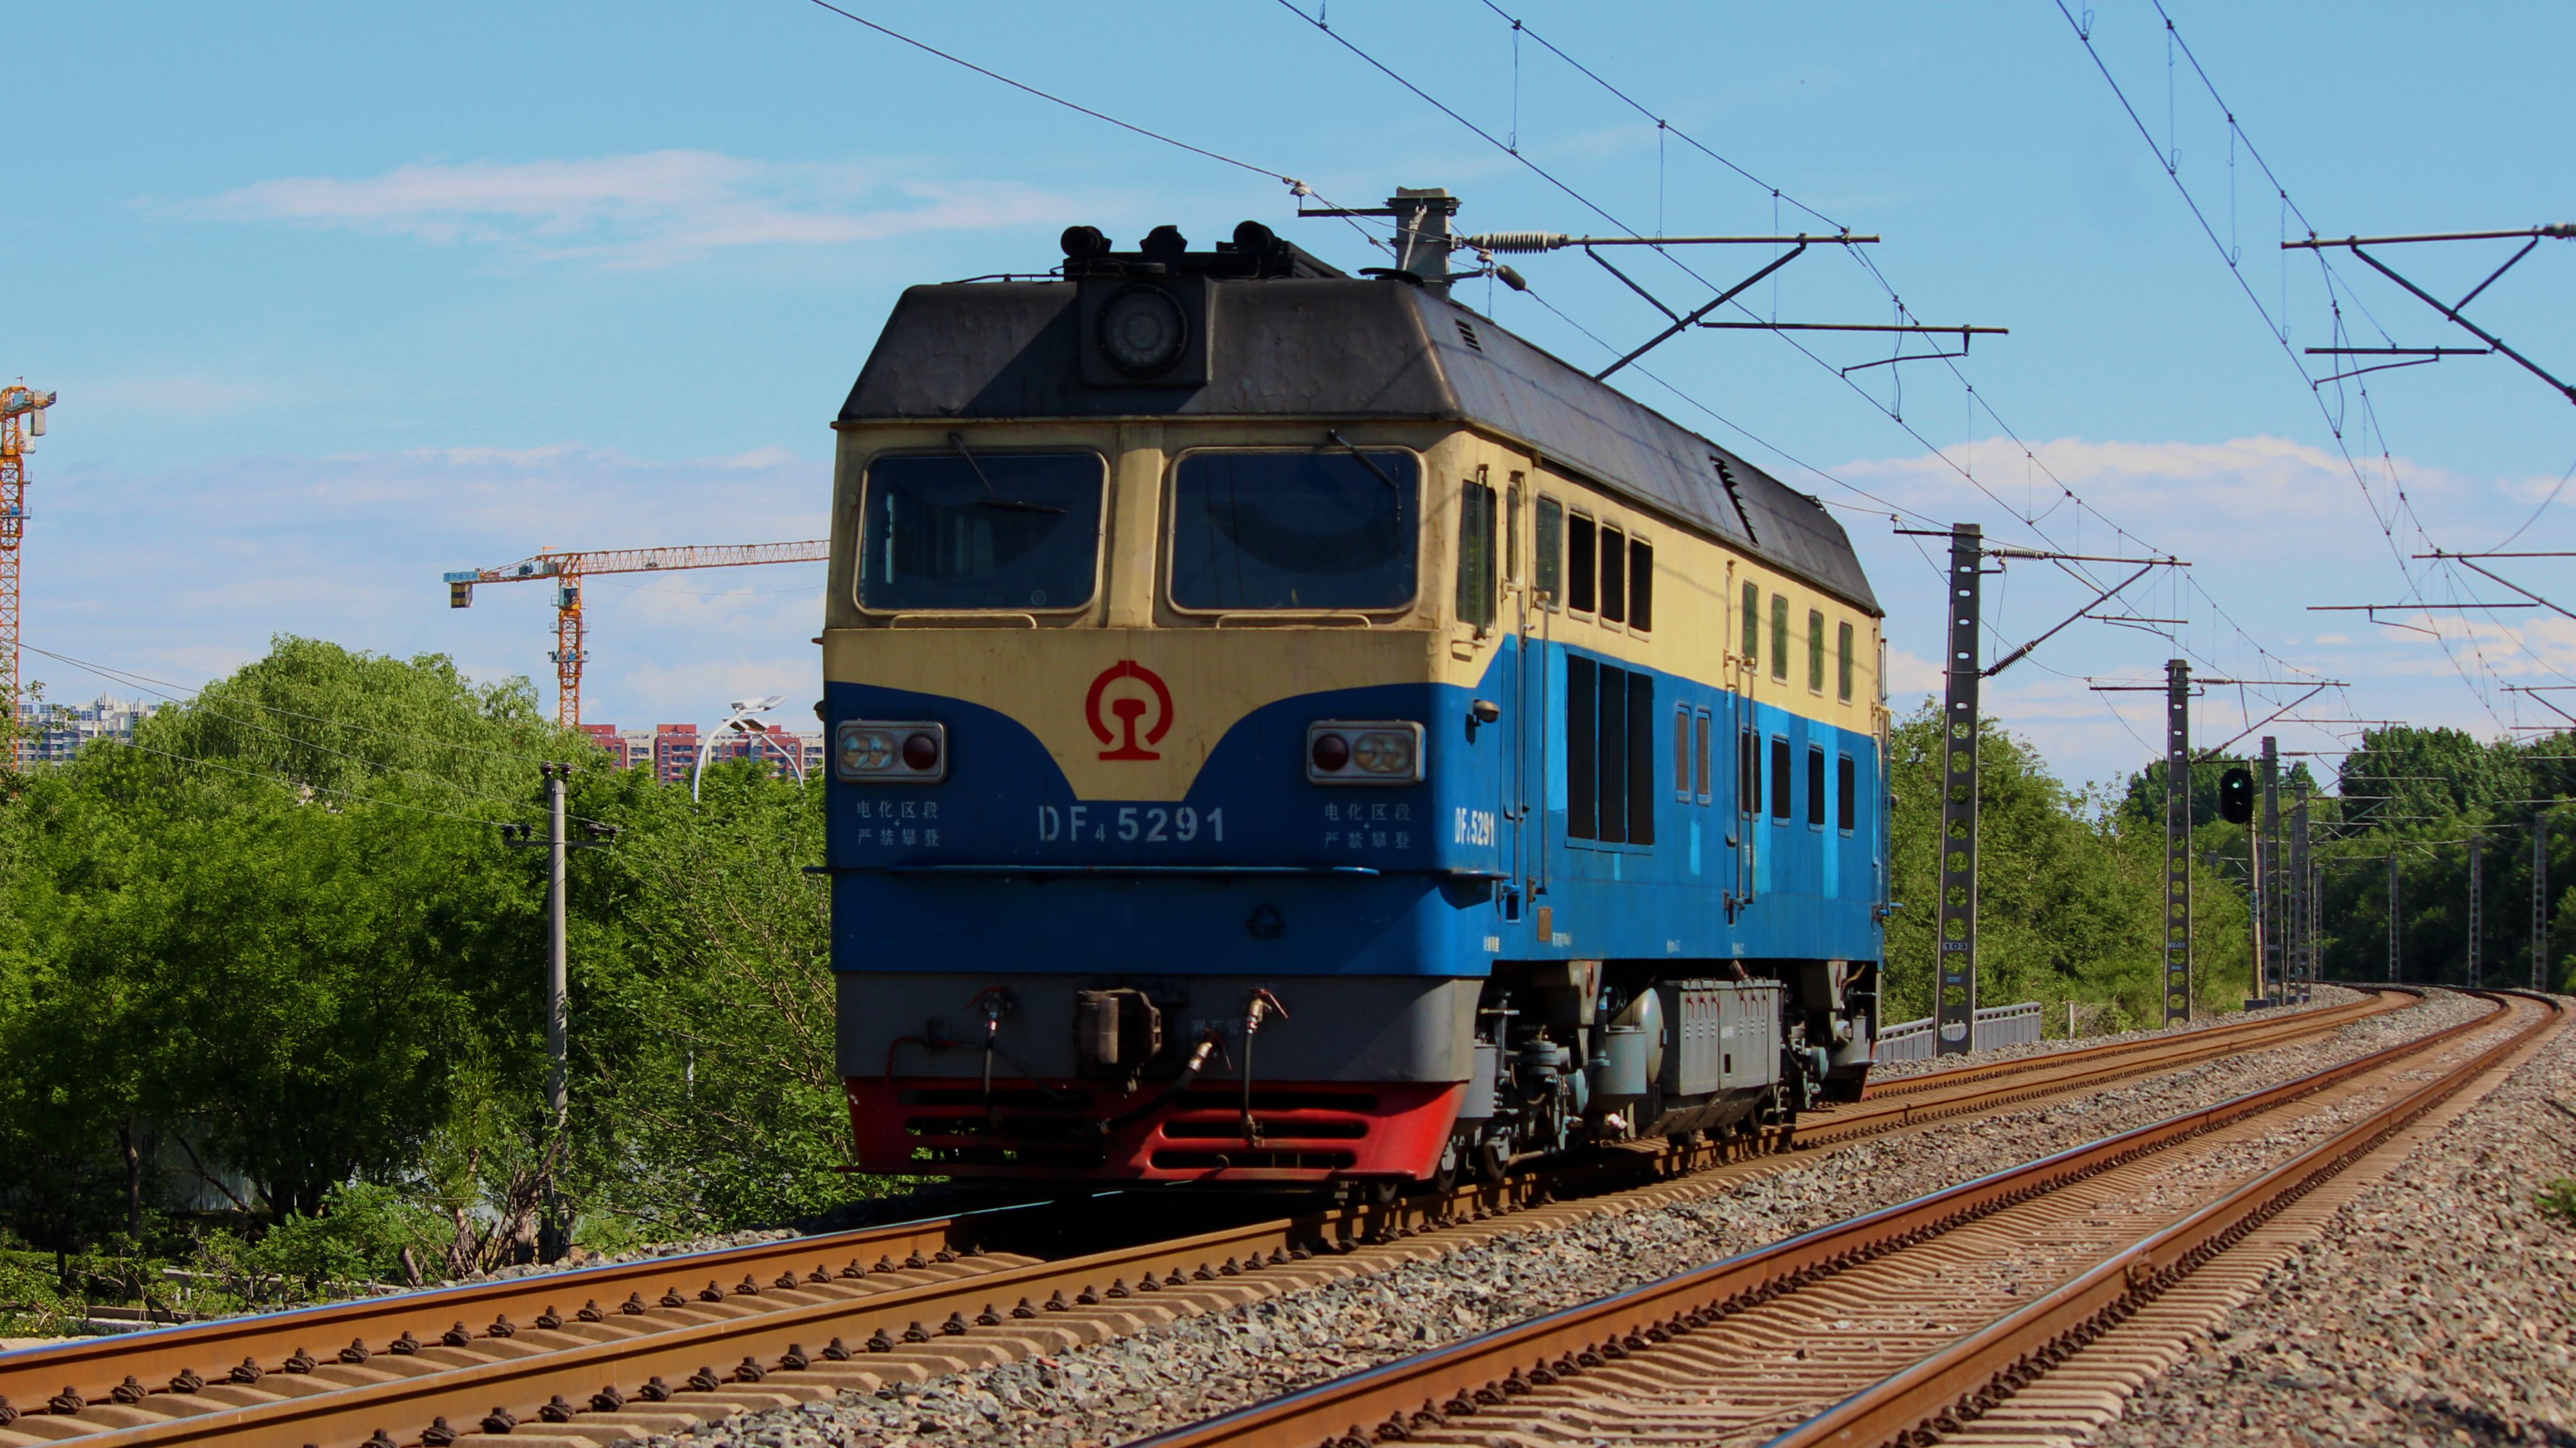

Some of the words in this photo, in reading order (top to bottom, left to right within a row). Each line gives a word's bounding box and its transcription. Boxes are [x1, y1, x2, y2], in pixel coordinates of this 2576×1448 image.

[857, 800, 938, 819] 电化区段
[1324, 802, 1411, 821] 电化区段
[857, 829, 939, 846] 严禁攀登
[1324, 831, 1411, 849] 严禁攀登
